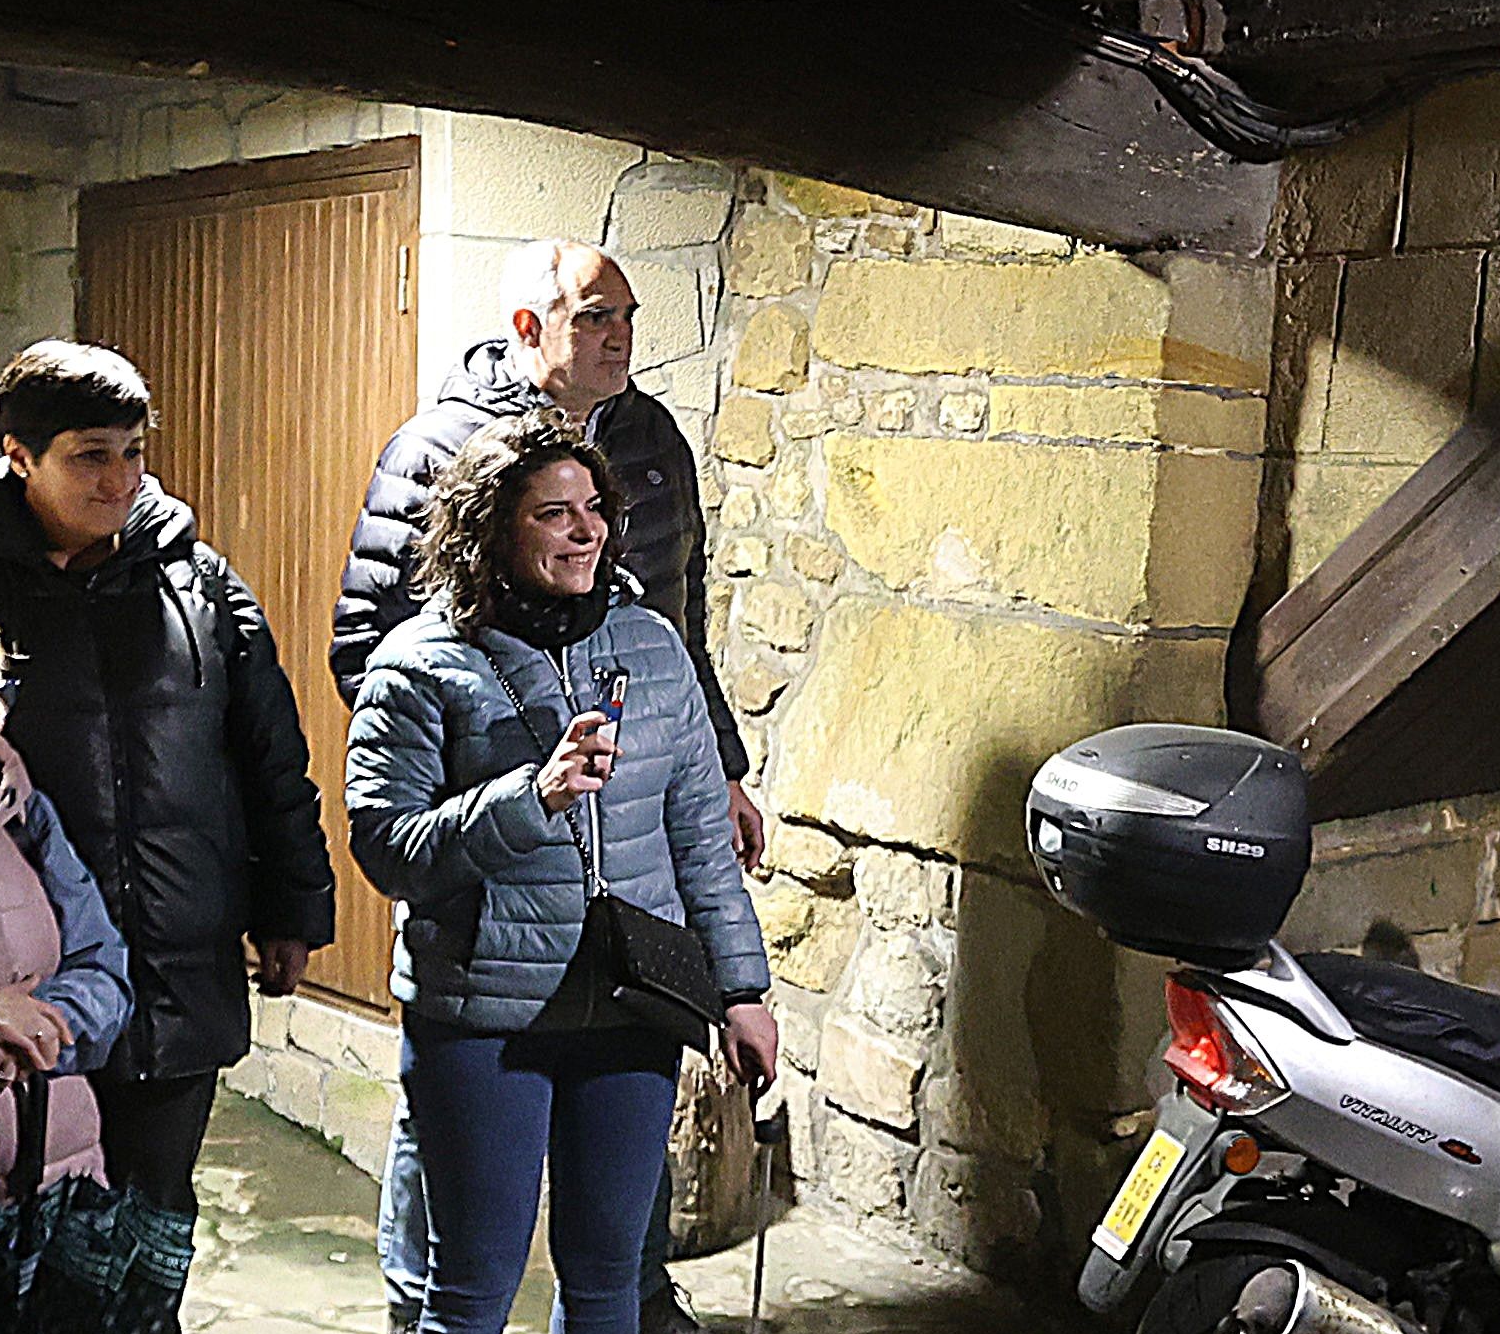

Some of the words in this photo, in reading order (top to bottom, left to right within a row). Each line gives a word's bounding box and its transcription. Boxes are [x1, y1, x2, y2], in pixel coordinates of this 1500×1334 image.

[1044, 771, 1079, 793] SHAD
[1206, 837, 1265, 858] SH29
[1339, 1093, 1438, 1144] VITALITY
